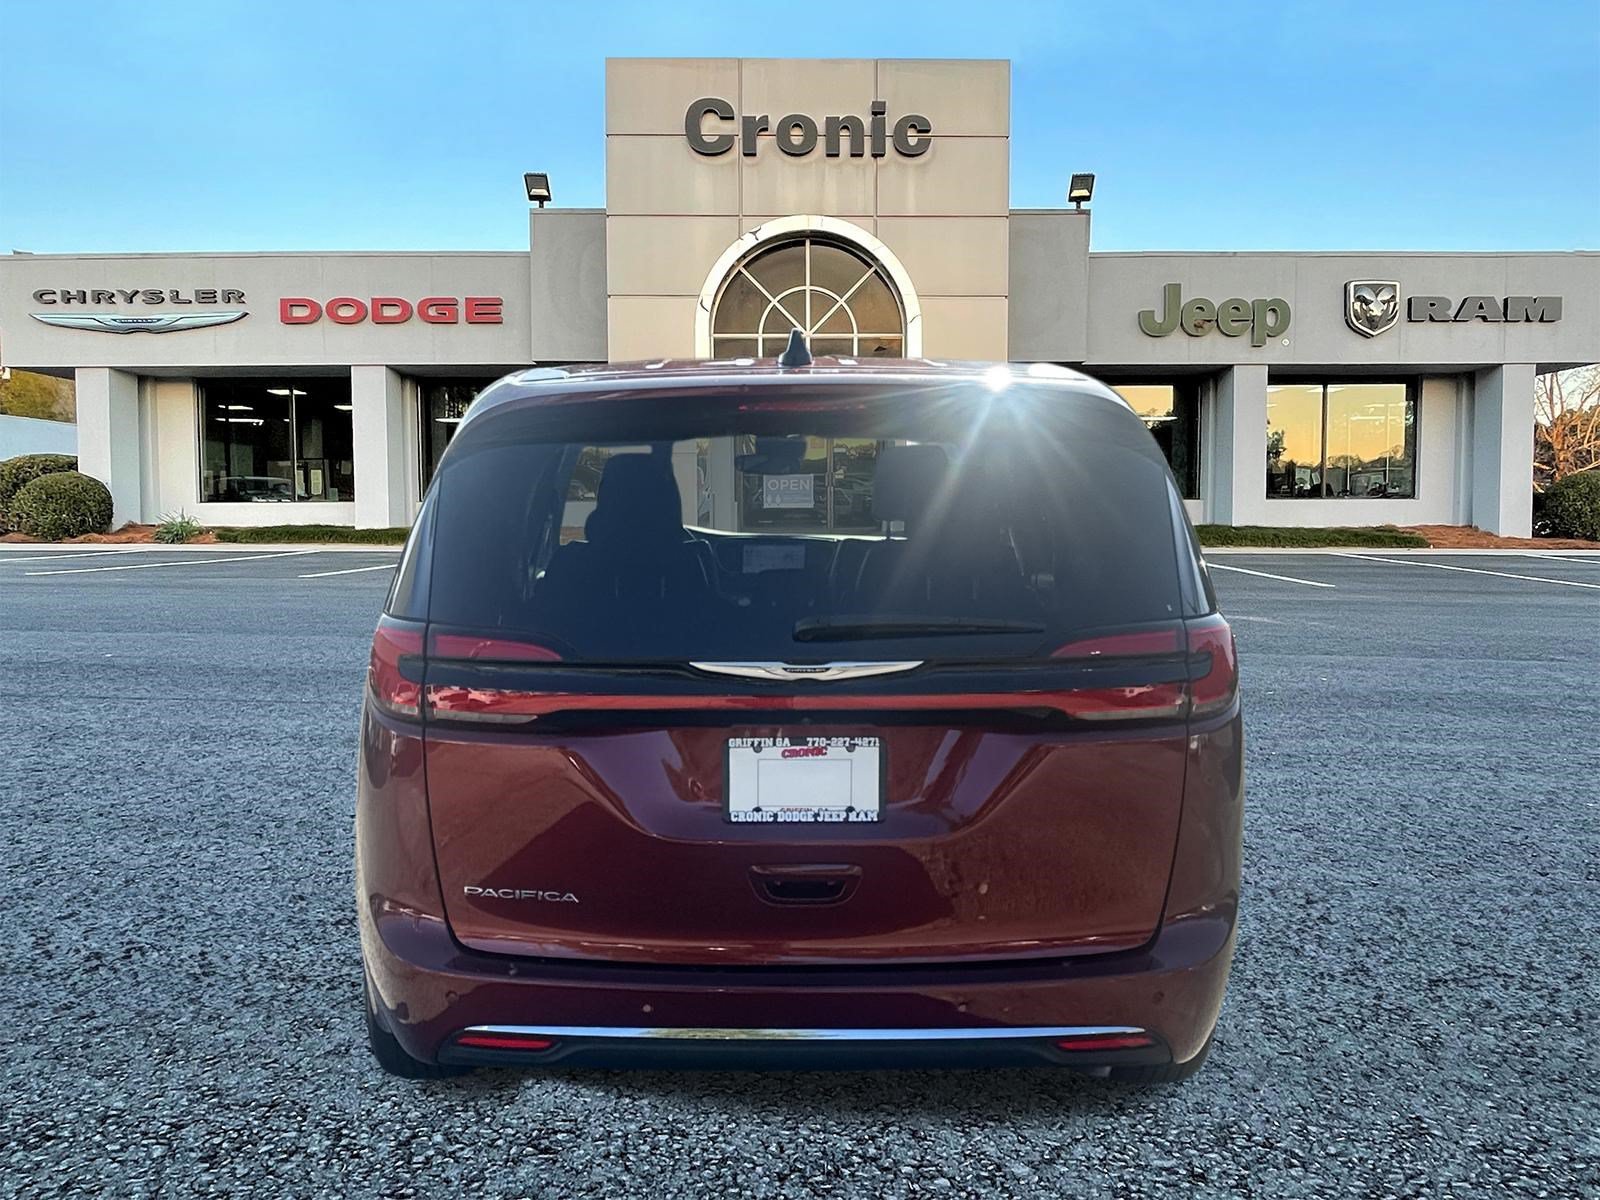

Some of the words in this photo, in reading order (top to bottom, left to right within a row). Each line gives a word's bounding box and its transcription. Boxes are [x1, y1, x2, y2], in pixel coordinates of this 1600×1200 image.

[684, 97, 932, 157] Cronic
[32, 289, 247, 304] CHRYSLER
[279, 297, 503, 324] DODGE
[1138, 283, 1291, 347] Jeep
[1407, 296, 1562, 322] RAM
[768, 479, 810, 490] OPEN
[728, 737, 774, 747] GRIFFIN
[775, 737, 791, 747] GA
[806, 737, 880, 747] 770-227-4271
[730, 811, 774, 822] CRONIC
[777, 811, 814, 822] DODGE
[817, 811, 846, 822] JEEP
[848, 811, 878, 822] RAM
[463, 886, 579, 903] PACIFICA
